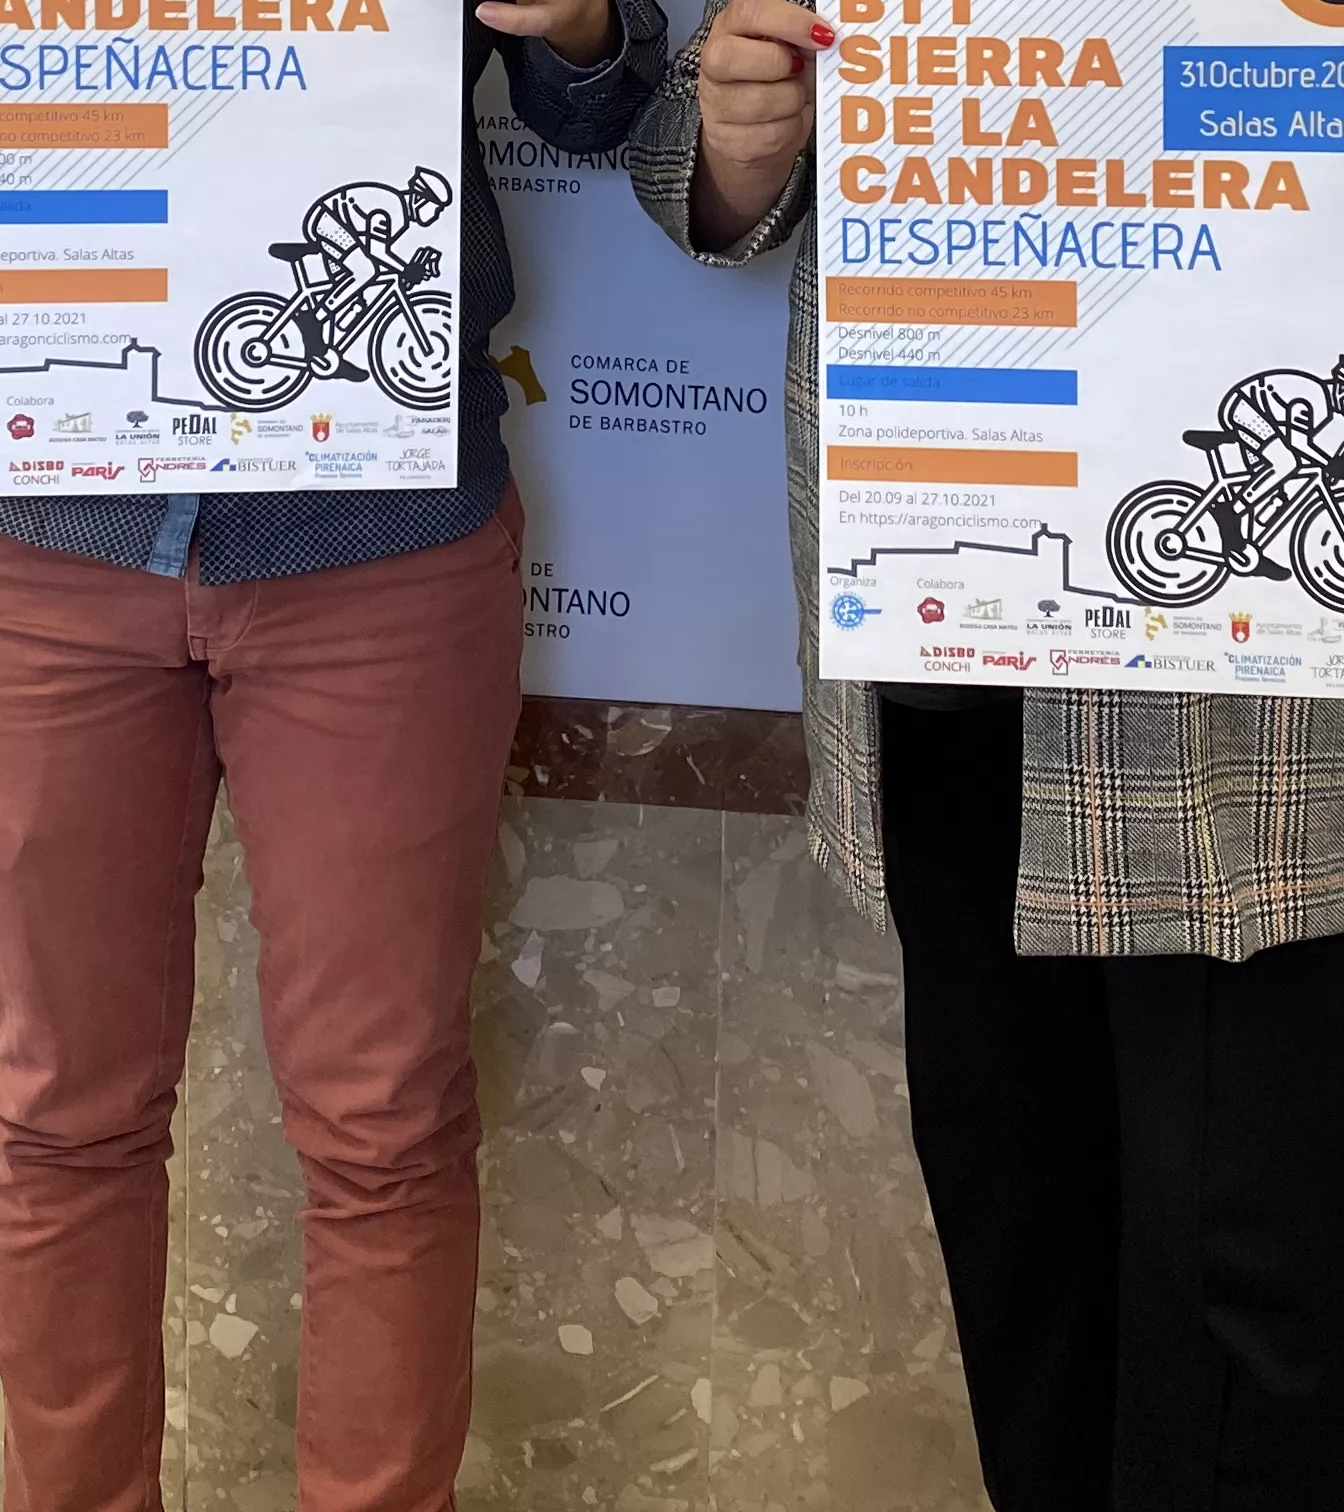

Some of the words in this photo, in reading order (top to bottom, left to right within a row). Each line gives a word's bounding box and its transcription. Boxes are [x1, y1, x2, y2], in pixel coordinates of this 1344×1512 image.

[840, 35, 1121, 86] SIERRA
[841, 96, 933, 144] DE
[963, 99, 1056, 146] LA
[1200, 110, 1277, 136] Salas
[841, 156, 1307, 210] CANDELERA
[841, 212, 1222, 270] DESPEÑACERA
[64, 249, 98, 261] Salas
[101, 248, 134, 260] Altas
[6, 396, 54, 406] Colabora
[178, 436, 212, 445] STORE
[238, 461, 296, 471] BISTUER
[315, 462, 362, 471] PIRENAICA
[13, 475, 59, 485] CONCHI
